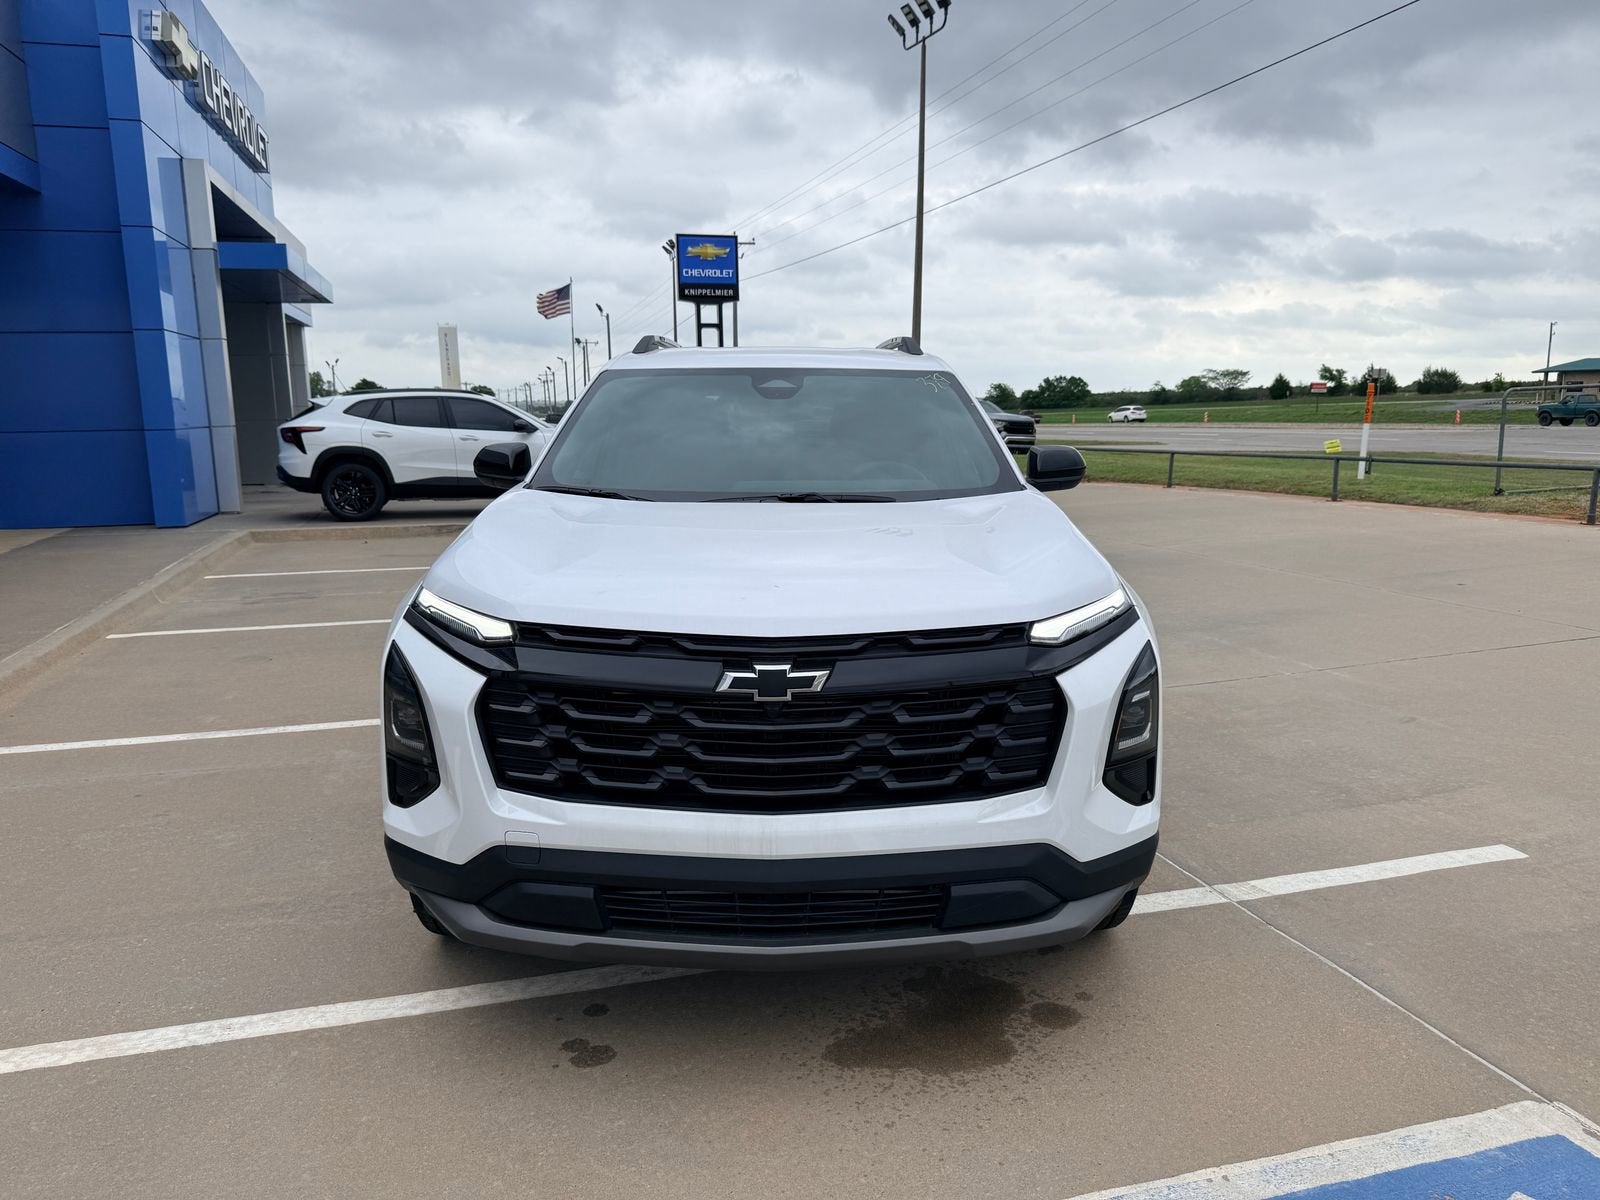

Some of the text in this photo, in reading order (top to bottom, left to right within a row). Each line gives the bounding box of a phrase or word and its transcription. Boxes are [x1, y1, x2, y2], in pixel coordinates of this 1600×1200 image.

[200, 50, 269, 171] CHEVROLET
[682, 268, 734, 278] CHEVROLET
[684, 288, 734, 296] KNIPPELMIER
